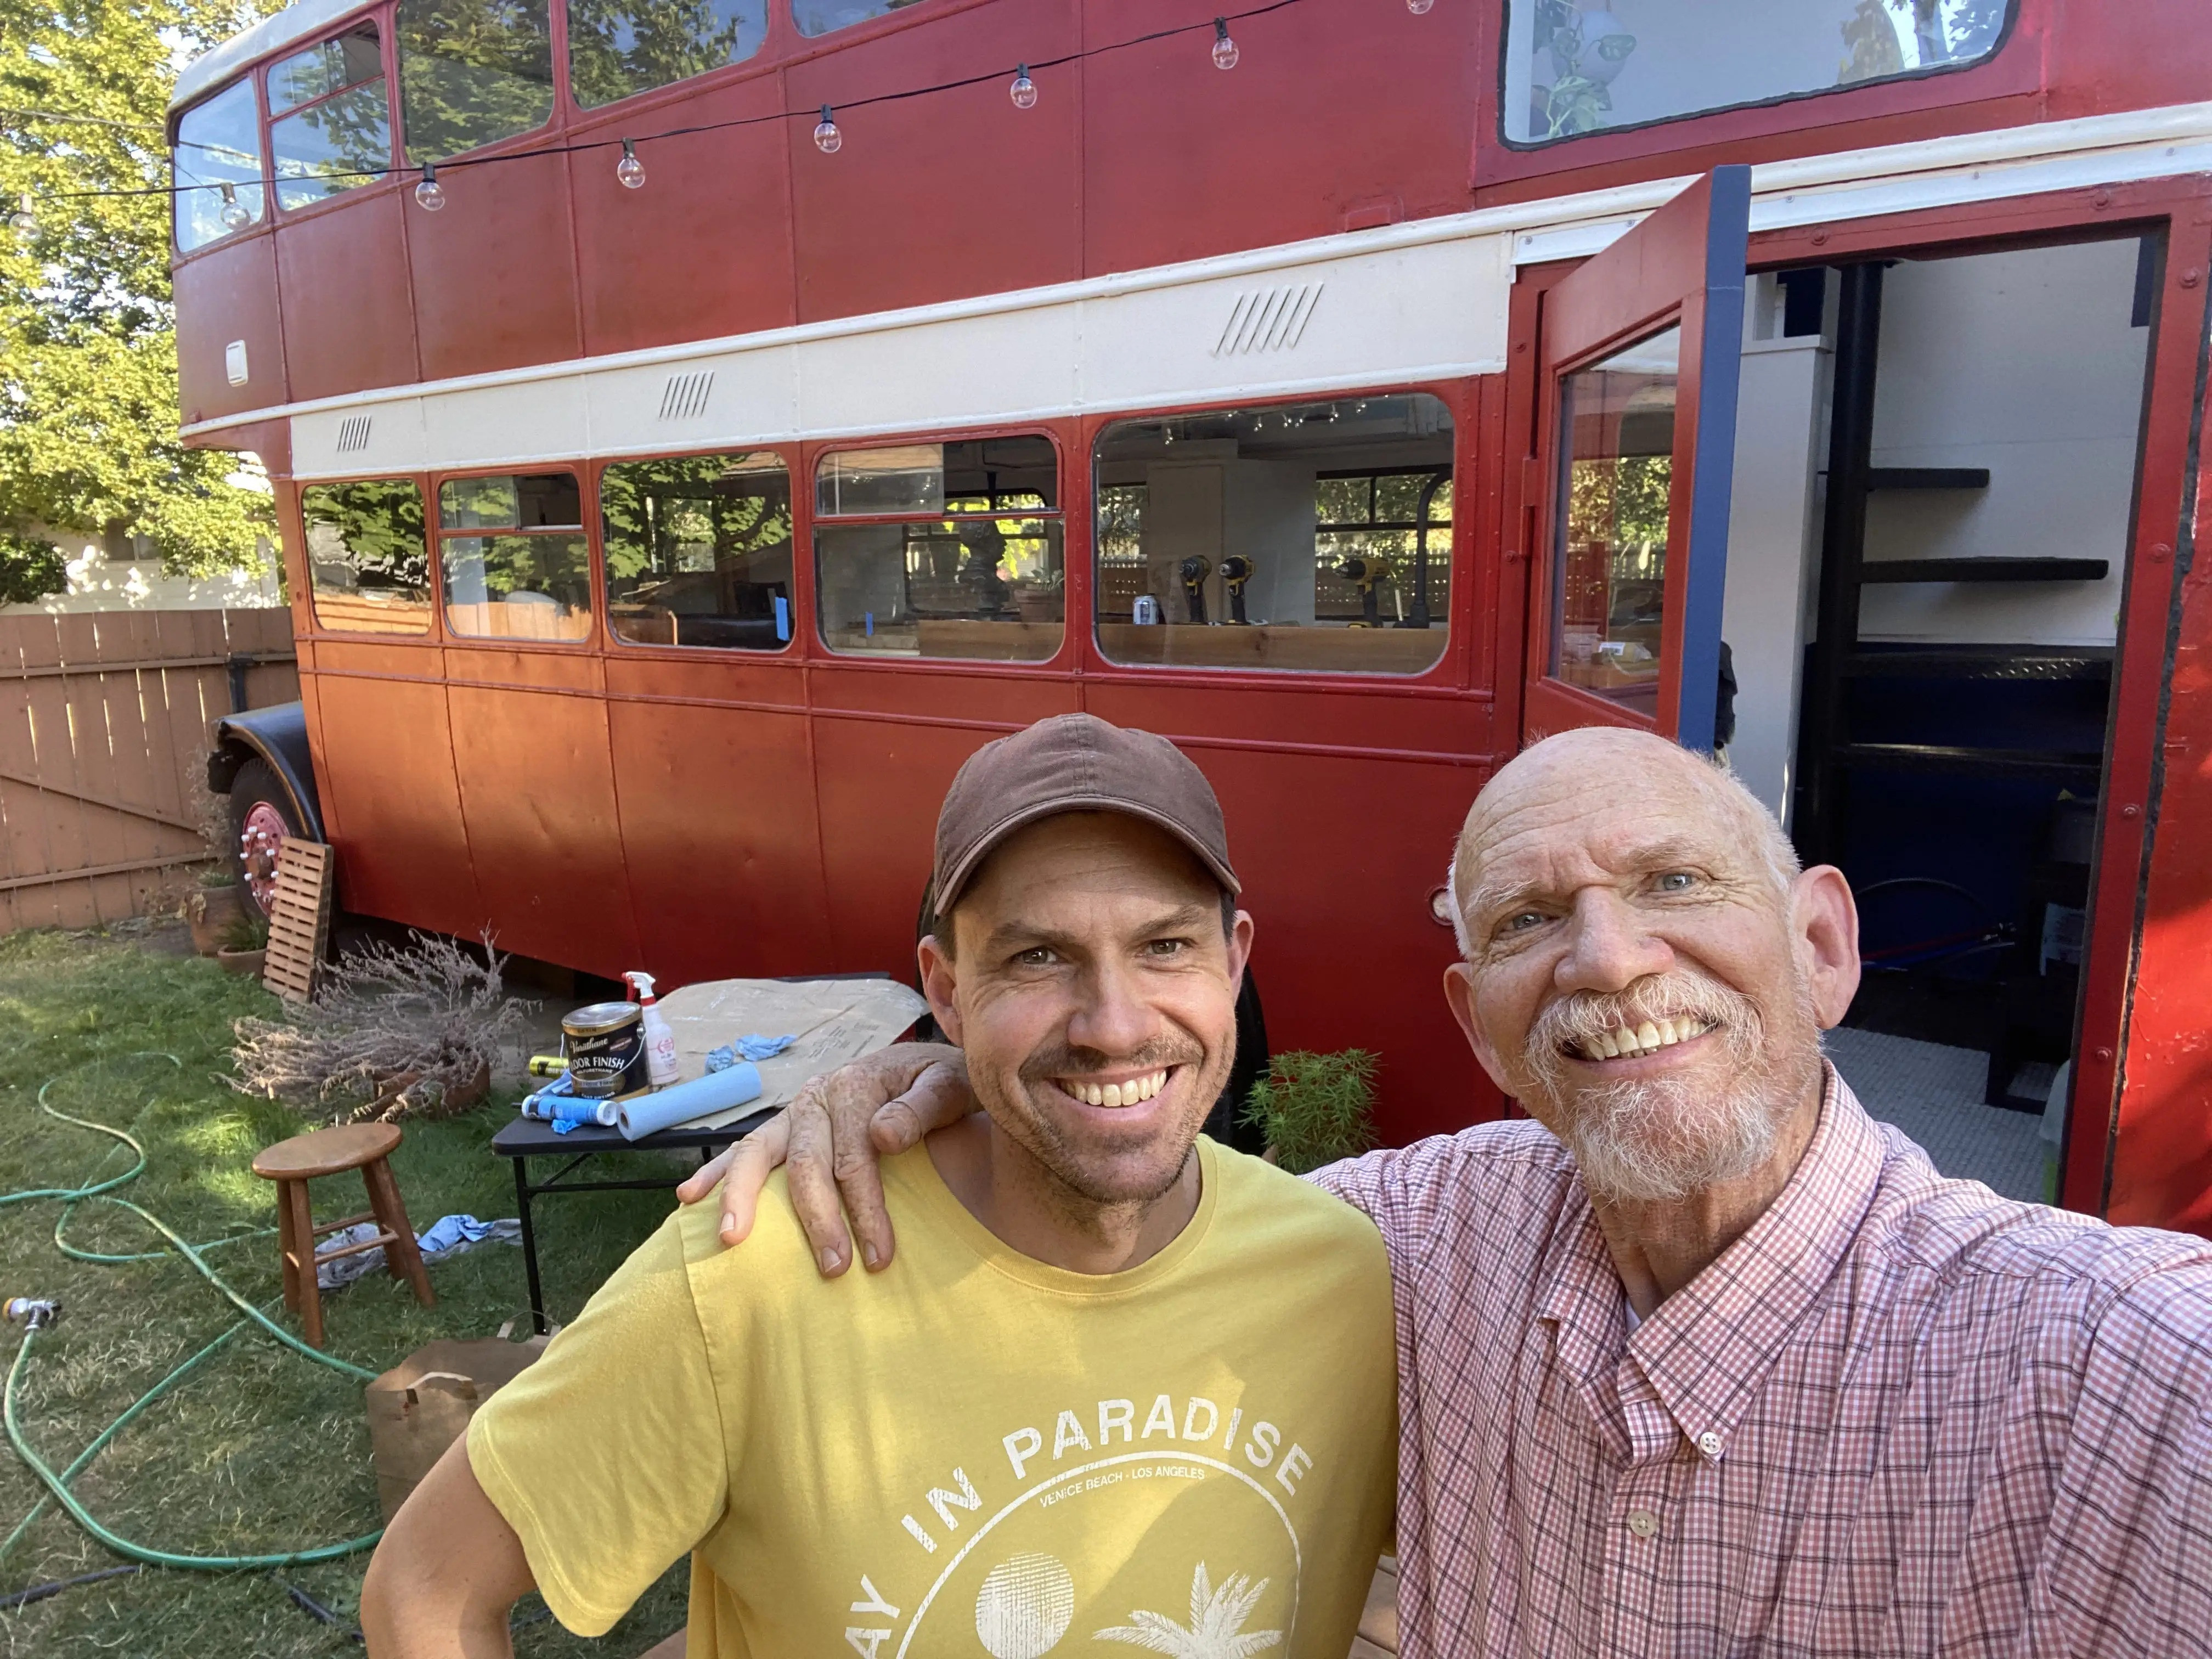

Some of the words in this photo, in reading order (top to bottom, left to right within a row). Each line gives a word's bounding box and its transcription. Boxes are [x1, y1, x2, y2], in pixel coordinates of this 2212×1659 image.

[593, 1057, 624, 1069] FINISH
[901, 1466, 983, 1554] IN
[1002, 1394, 1314, 1497] PARADISE
[1040, 1482, 1084, 1508] VENICE
[1086, 1471, 1124, 1491] BEACH
[1132, 1468, 1153, 1479] LOS
[1155, 1465, 1205, 1480] ANGELES
